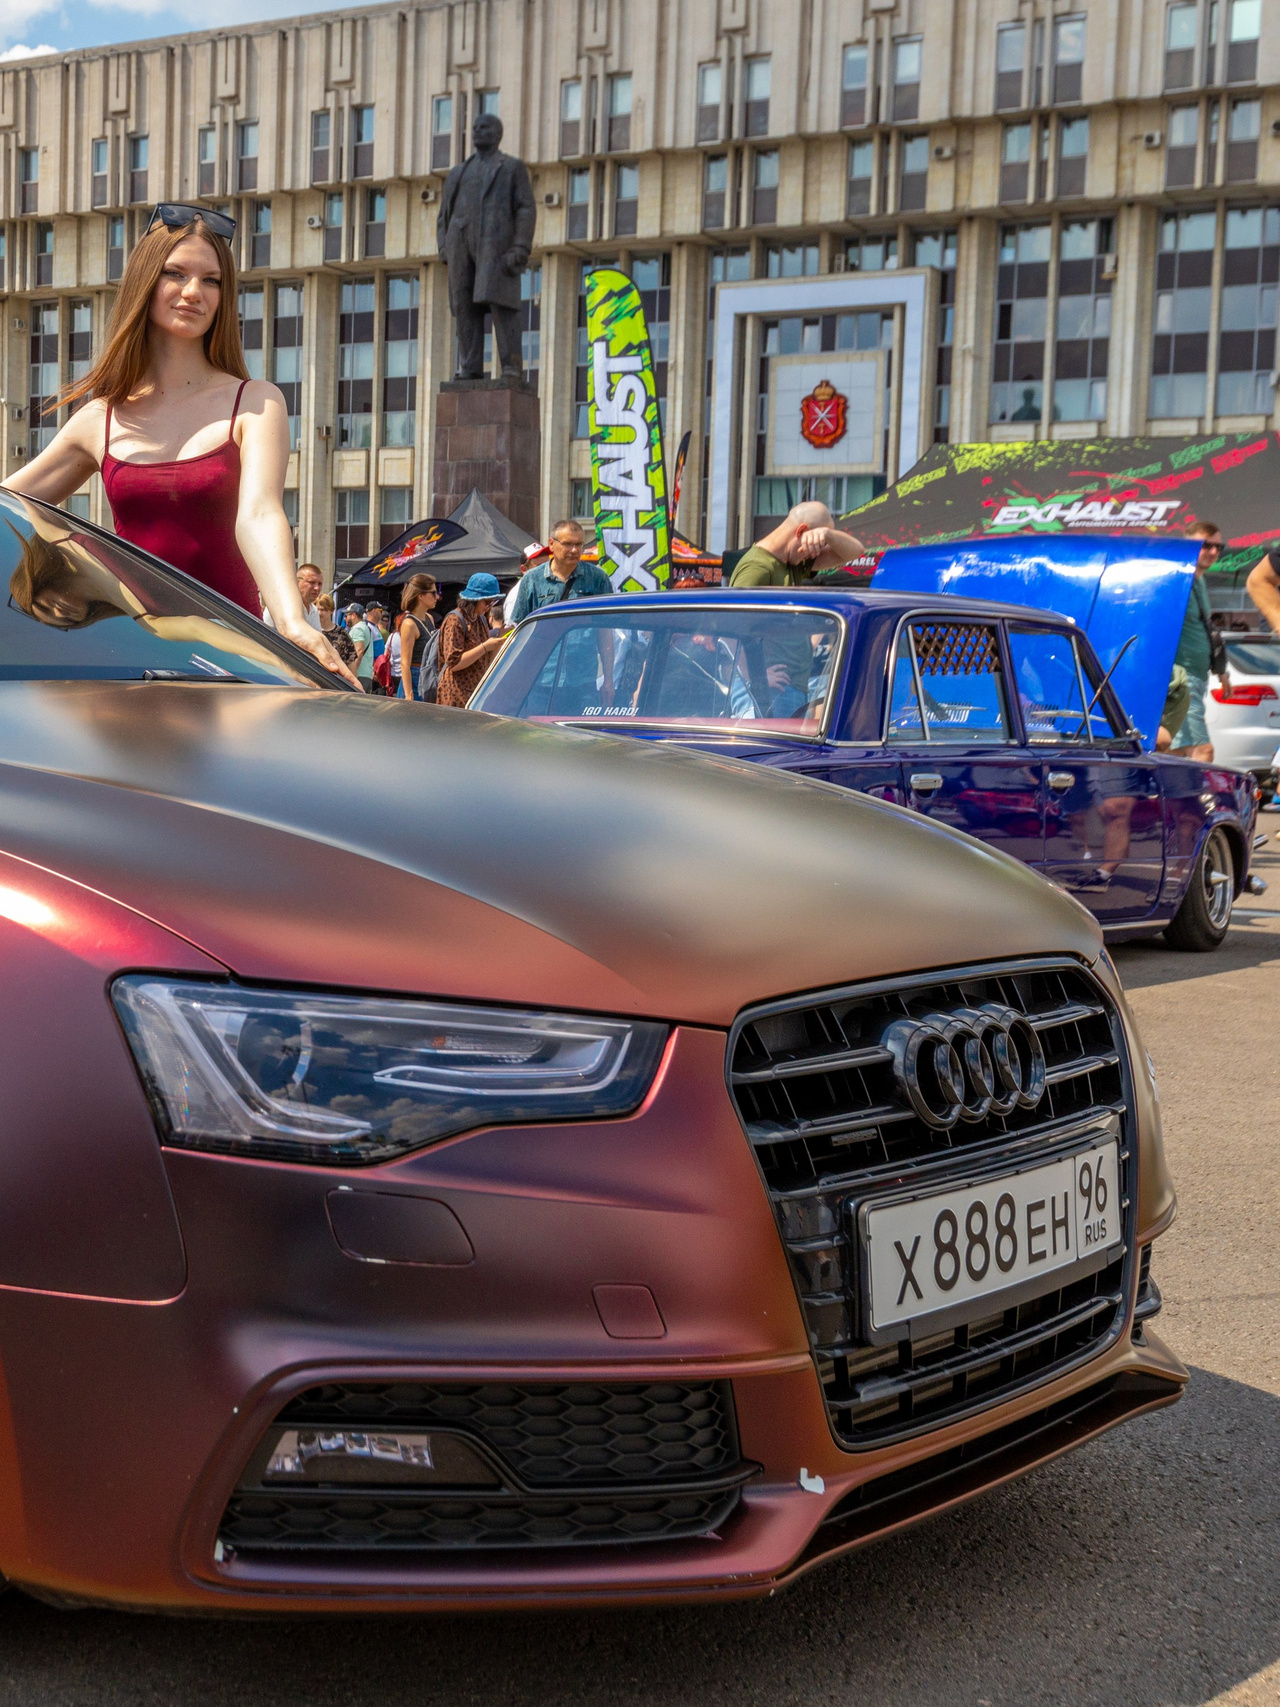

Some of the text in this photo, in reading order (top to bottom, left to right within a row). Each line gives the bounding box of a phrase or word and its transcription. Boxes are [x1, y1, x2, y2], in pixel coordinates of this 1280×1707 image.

[991, 500, 1182, 527] EXHAUST
[1078, 1154, 1108, 1220] 96
[1084, 1217, 1108, 1247] RUS
